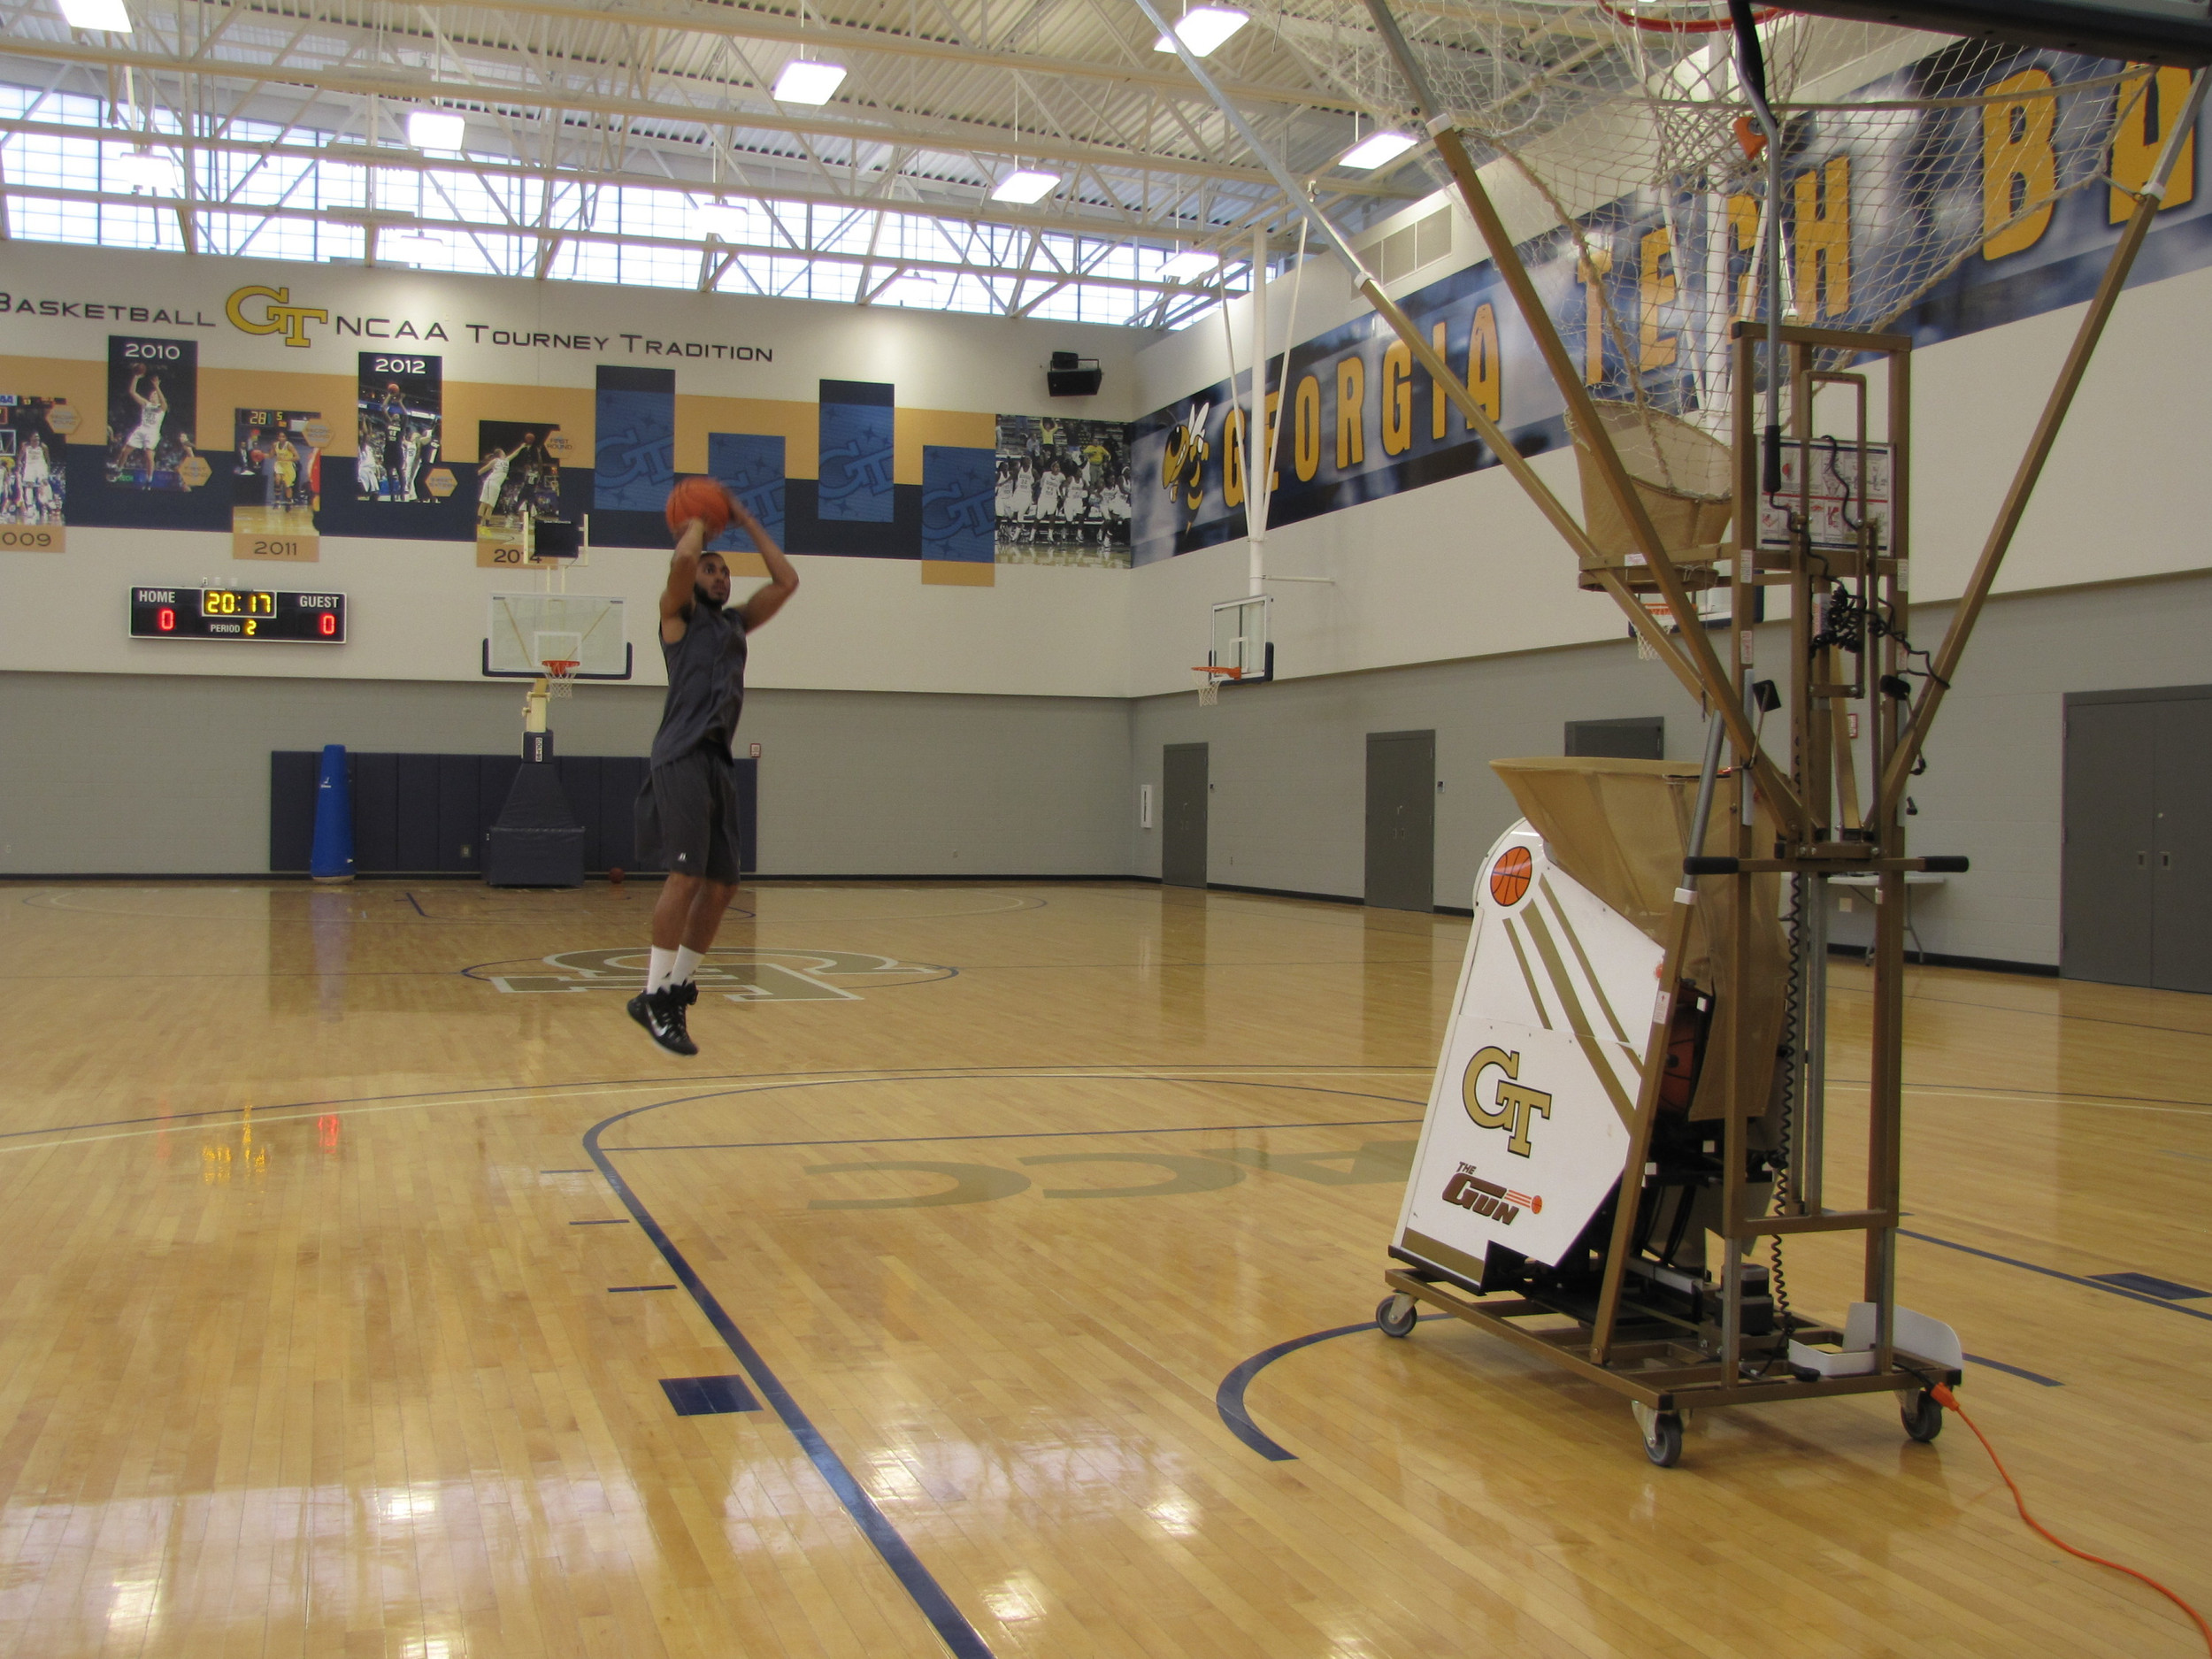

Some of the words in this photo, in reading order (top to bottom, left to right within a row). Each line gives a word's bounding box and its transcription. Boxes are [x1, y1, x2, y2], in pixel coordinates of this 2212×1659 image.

[226, 285, 328, 348] GT
[336, 316, 449, 342] NCAA
[465, 324, 610, 350] TOURNEY
[620, 334, 773, 362] TRADITION
[125, 343, 180, 360] 2010
[375, 358, 426, 374] 2012
[1223, 303, 1501, 508] GEORGIA
[254, 541, 297, 556] 2011
[494, 549, 542, 564] 204
[139, 590, 176, 603] HOME
[207, 592, 272, 613] 20:17
[299, 595, 340, 609] GUEST
[160, 610, 175, 631] 0
[210, 624, 241, 634] PERIOD
[246, 620, 257, 635] 2
[322, 614, 335, 635] 0
[1462, 1045, 1553, 1159] GT
[1455, 1161, 1477, 1175] THE
[1441, 1172, 1520, 1225] GUN
